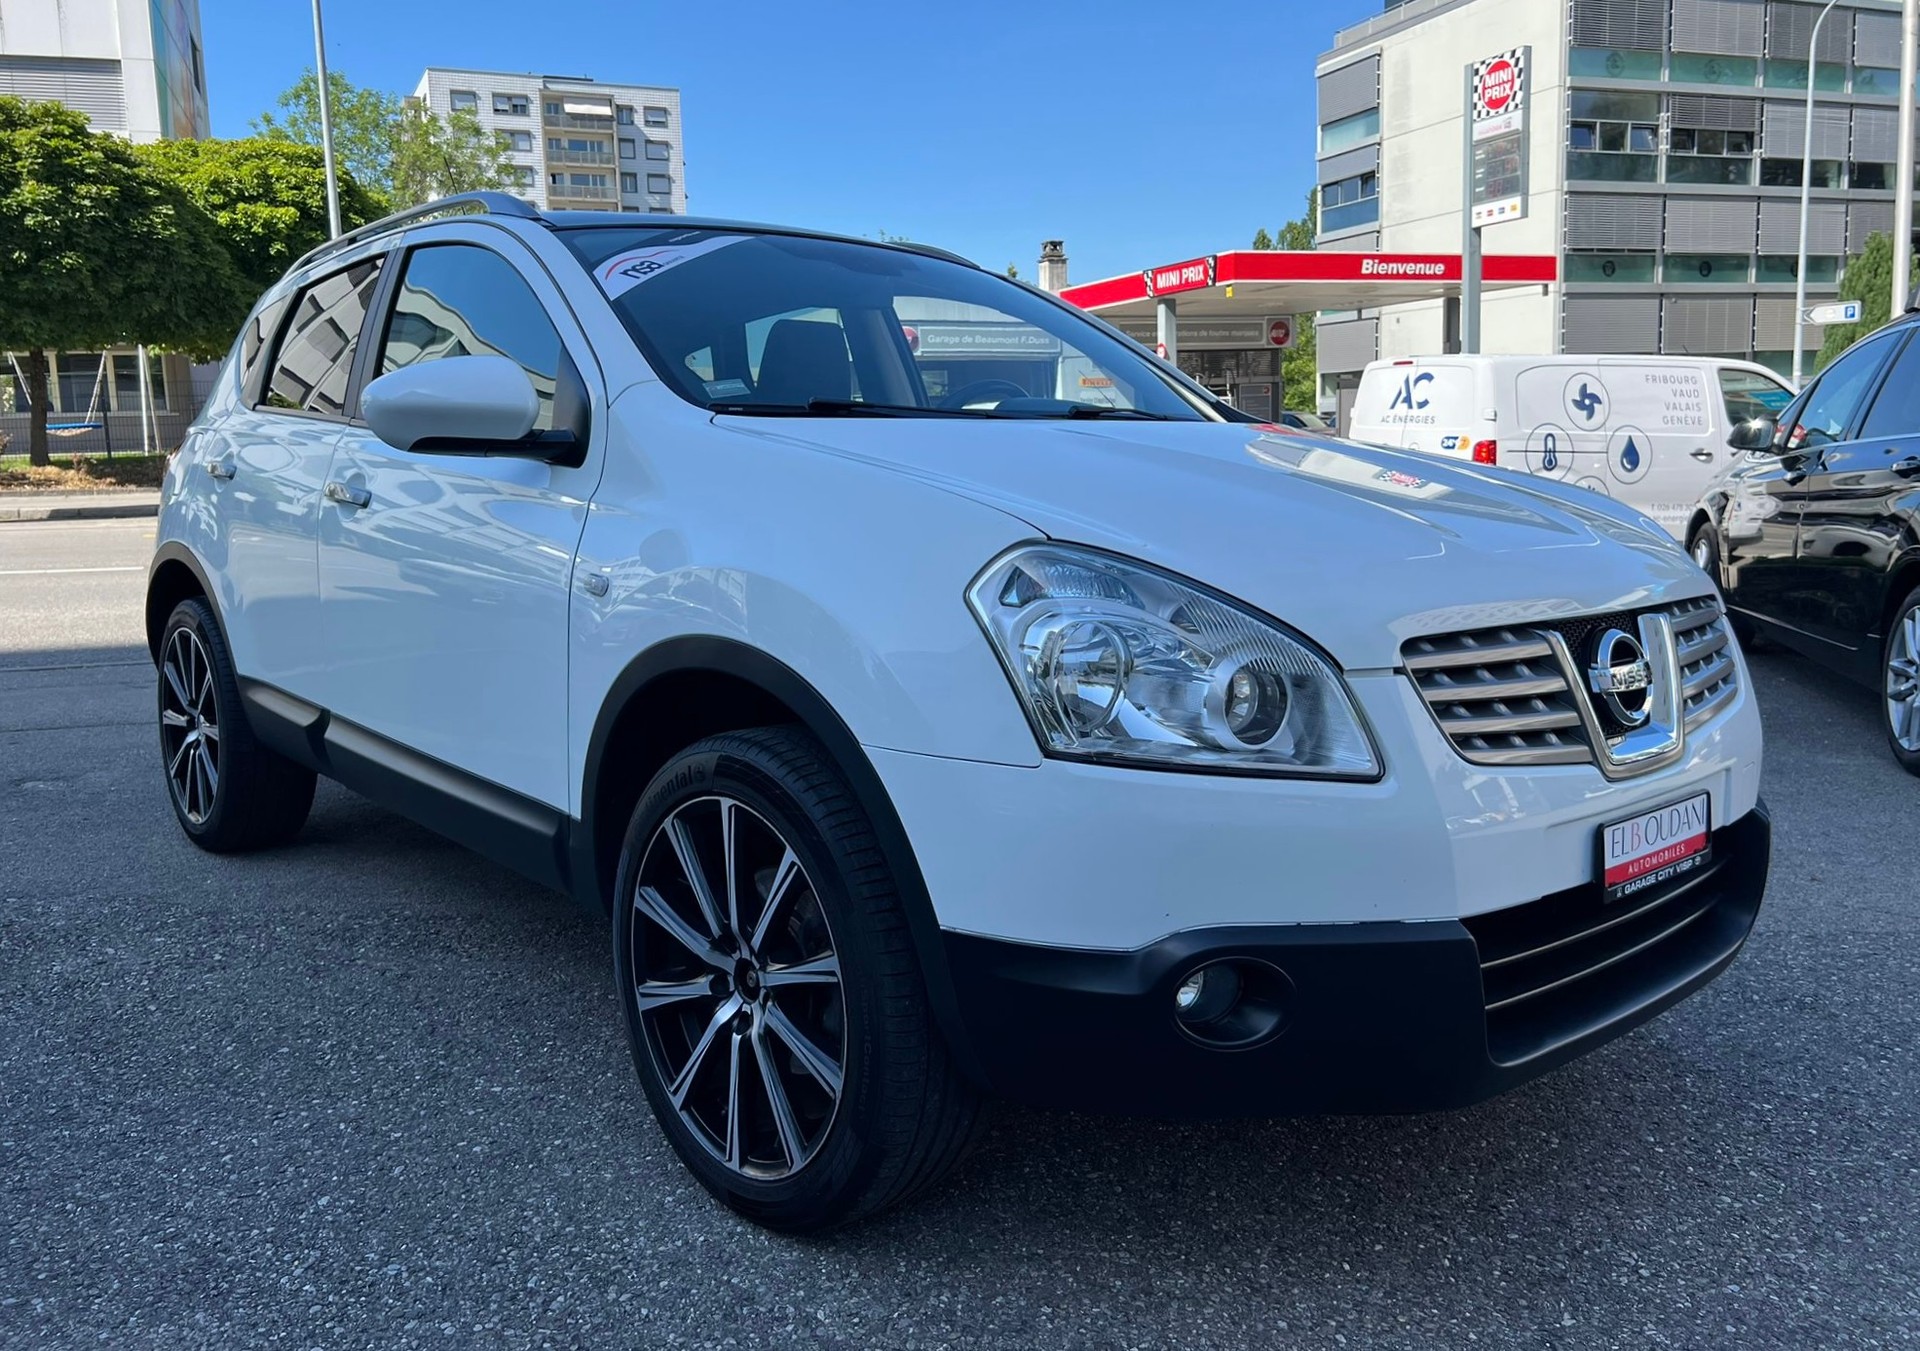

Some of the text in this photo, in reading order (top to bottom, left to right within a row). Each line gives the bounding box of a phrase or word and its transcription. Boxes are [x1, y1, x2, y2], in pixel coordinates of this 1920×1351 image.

[1485, 67, 1512, 88] MINI
[1484, 81, 1511, 103] PRIX
[619, 261, 664, 279] nsa
[1361, 259, 1445, 275] Bienvenue
[1156, 264, 1205, 289] MINI PRIX
[927, 334, 960, 345] Garage
[961, 334, 972, 343] de
[974, 334, 1018, 344] Beaumont
[1645, 374, 1698, 385] FRIBOURG
[1389, 372, 1435, 410] AC
[1671, 388, 1700, 398] VAUD
[1664, 401, 1702, 412] VALAIS
[1381, 415, 1391, 423] AC
[1662, 414, 1703, 426] GENÈVE
[1627, 843, 1686, 874] AUTOMOBILES
[1624, 859, 1694, 894] GARAGE CITY VISP
